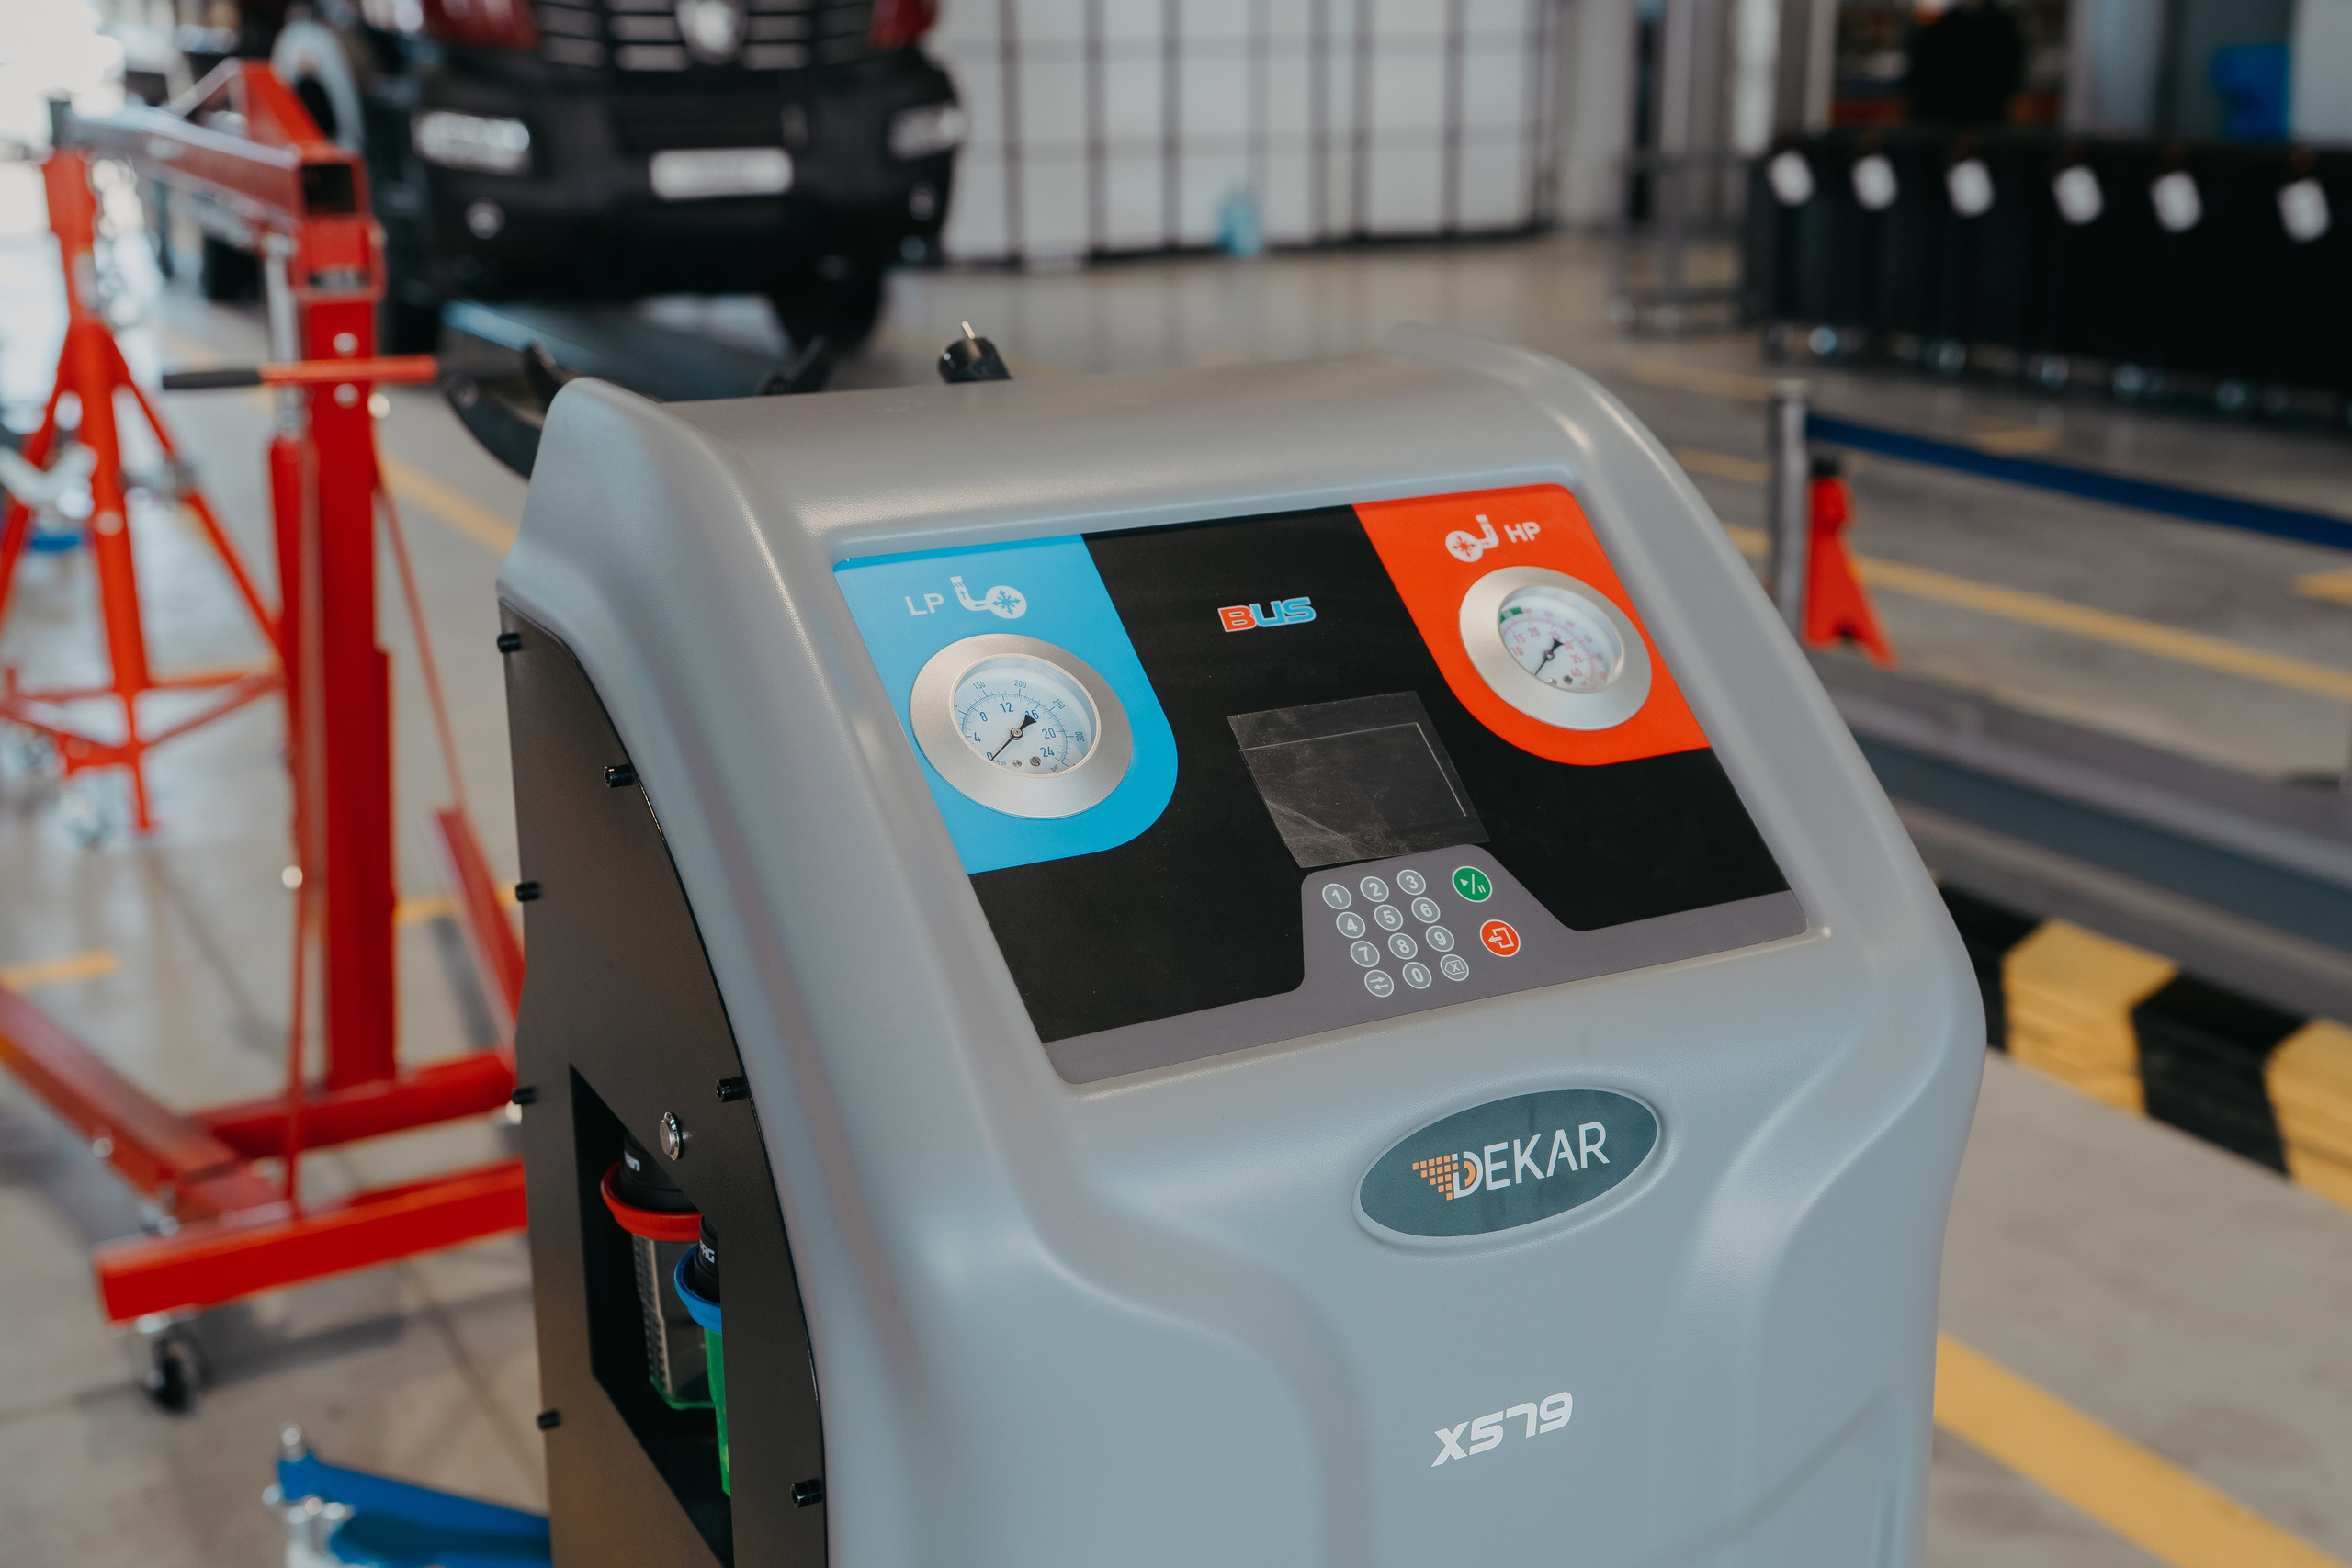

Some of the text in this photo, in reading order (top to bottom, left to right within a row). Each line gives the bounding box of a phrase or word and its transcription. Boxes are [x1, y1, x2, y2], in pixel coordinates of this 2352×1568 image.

[1504, 522, 1541, 543] HP
[905, 592, 944, 616] LP
[1217, 596, 1317, 633] BUS
[973, 681, 987, 691] 150
[1014, 679, 1027, 689] 200
[999, 702, 1014, 713] 12
[1052, 698, 1066, 710] 250
[979, 711, 989, 722] 8
[974, 732, 981, 742] 4
[1041, 728, 1057, 739] 20
[986, 751, 993, 761] 0
[1040, 746, 1055, 758] 24
[1405, 874, 1419, 889] 3
[1331, 889, 1343, 903] 1
[1368, 882, 1383, 897] 2
[1383, 910, 1396, 925] 5
[1419, 903, 1433, 918] 6
[1346, 918, 1359, 932] 4
[1433, 931, 1447, 946] 9
[1396, 939, 1410, 953] 8
[1358, 946, 1369, 962] 7
[1411, 967, 1424, 983] 0
[1452, 1122, 1610, 1199] DEKAR
[1430, 1391, 1574, 1468] X579
